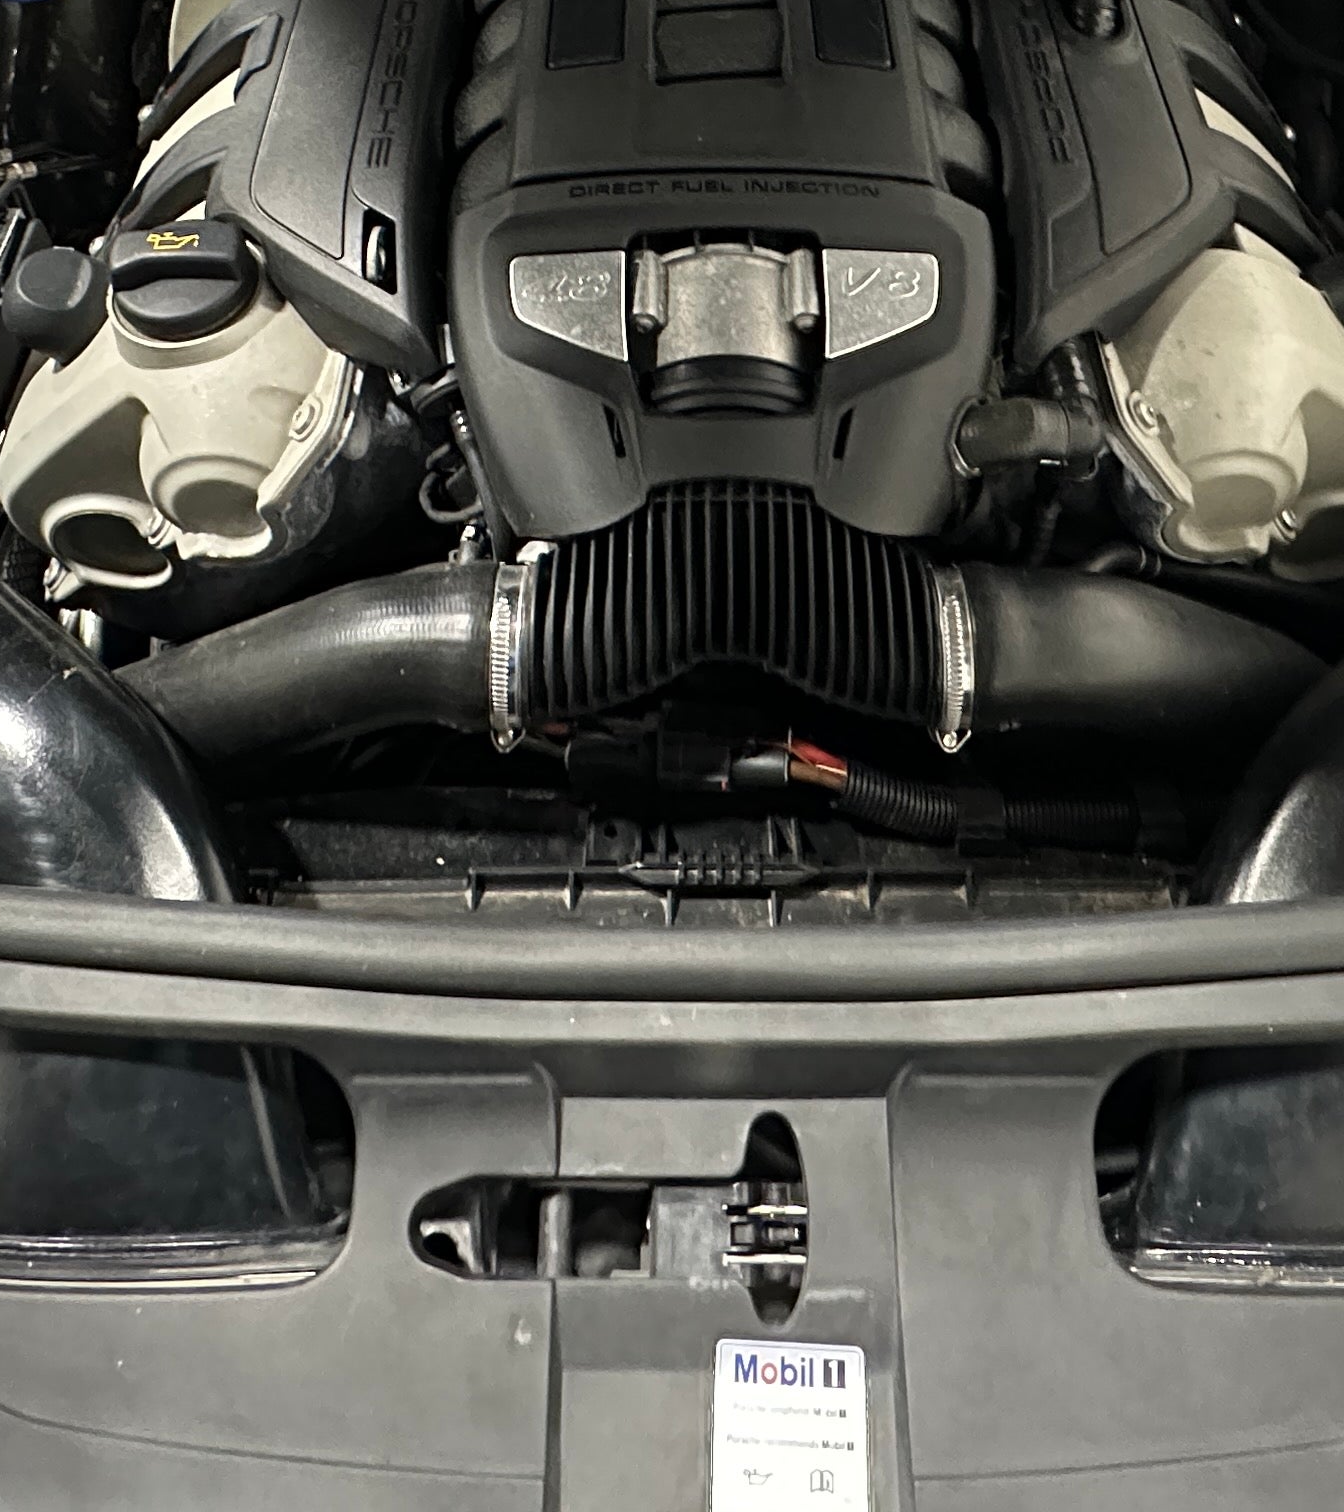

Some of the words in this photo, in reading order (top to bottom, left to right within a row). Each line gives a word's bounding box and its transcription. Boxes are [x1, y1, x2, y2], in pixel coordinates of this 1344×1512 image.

[567, 179, 661, 199] DIRECT
[671, 178, 734, 194] FUEL
[744, 178, 882, 200] INJECTION
[734, 1353, 815, 1388] Mobil
[825, 1359, 843, 1388] 1
